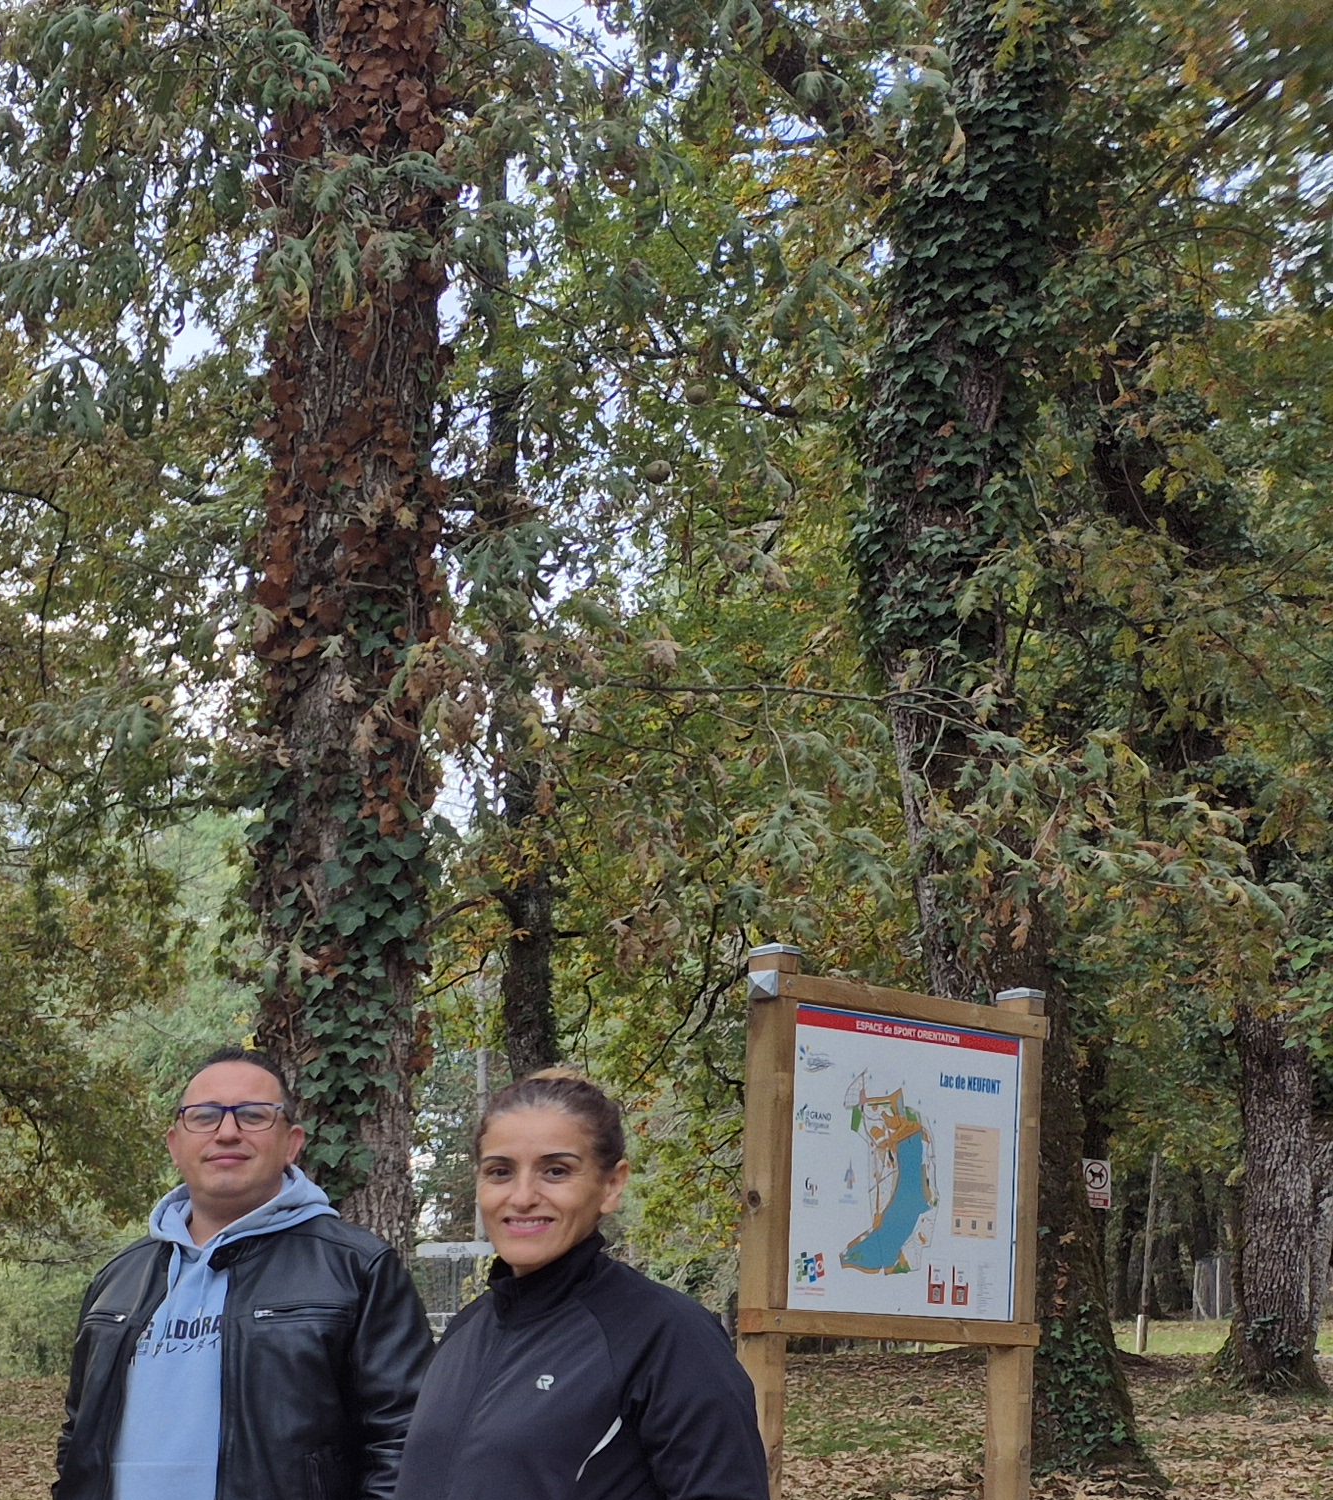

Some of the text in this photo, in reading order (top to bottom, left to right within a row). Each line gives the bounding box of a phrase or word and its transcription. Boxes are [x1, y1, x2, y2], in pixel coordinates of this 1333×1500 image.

[856, 1020, 883, 1033] ESPACE
[894, 1026, 915, 1037] SPORT
[917, 1030, 960, 1044] ORIENTATION
[939, 1072, 1001, 1094] Lac de NEUFONT
[810, 1111, 831, 1121] GRAND
